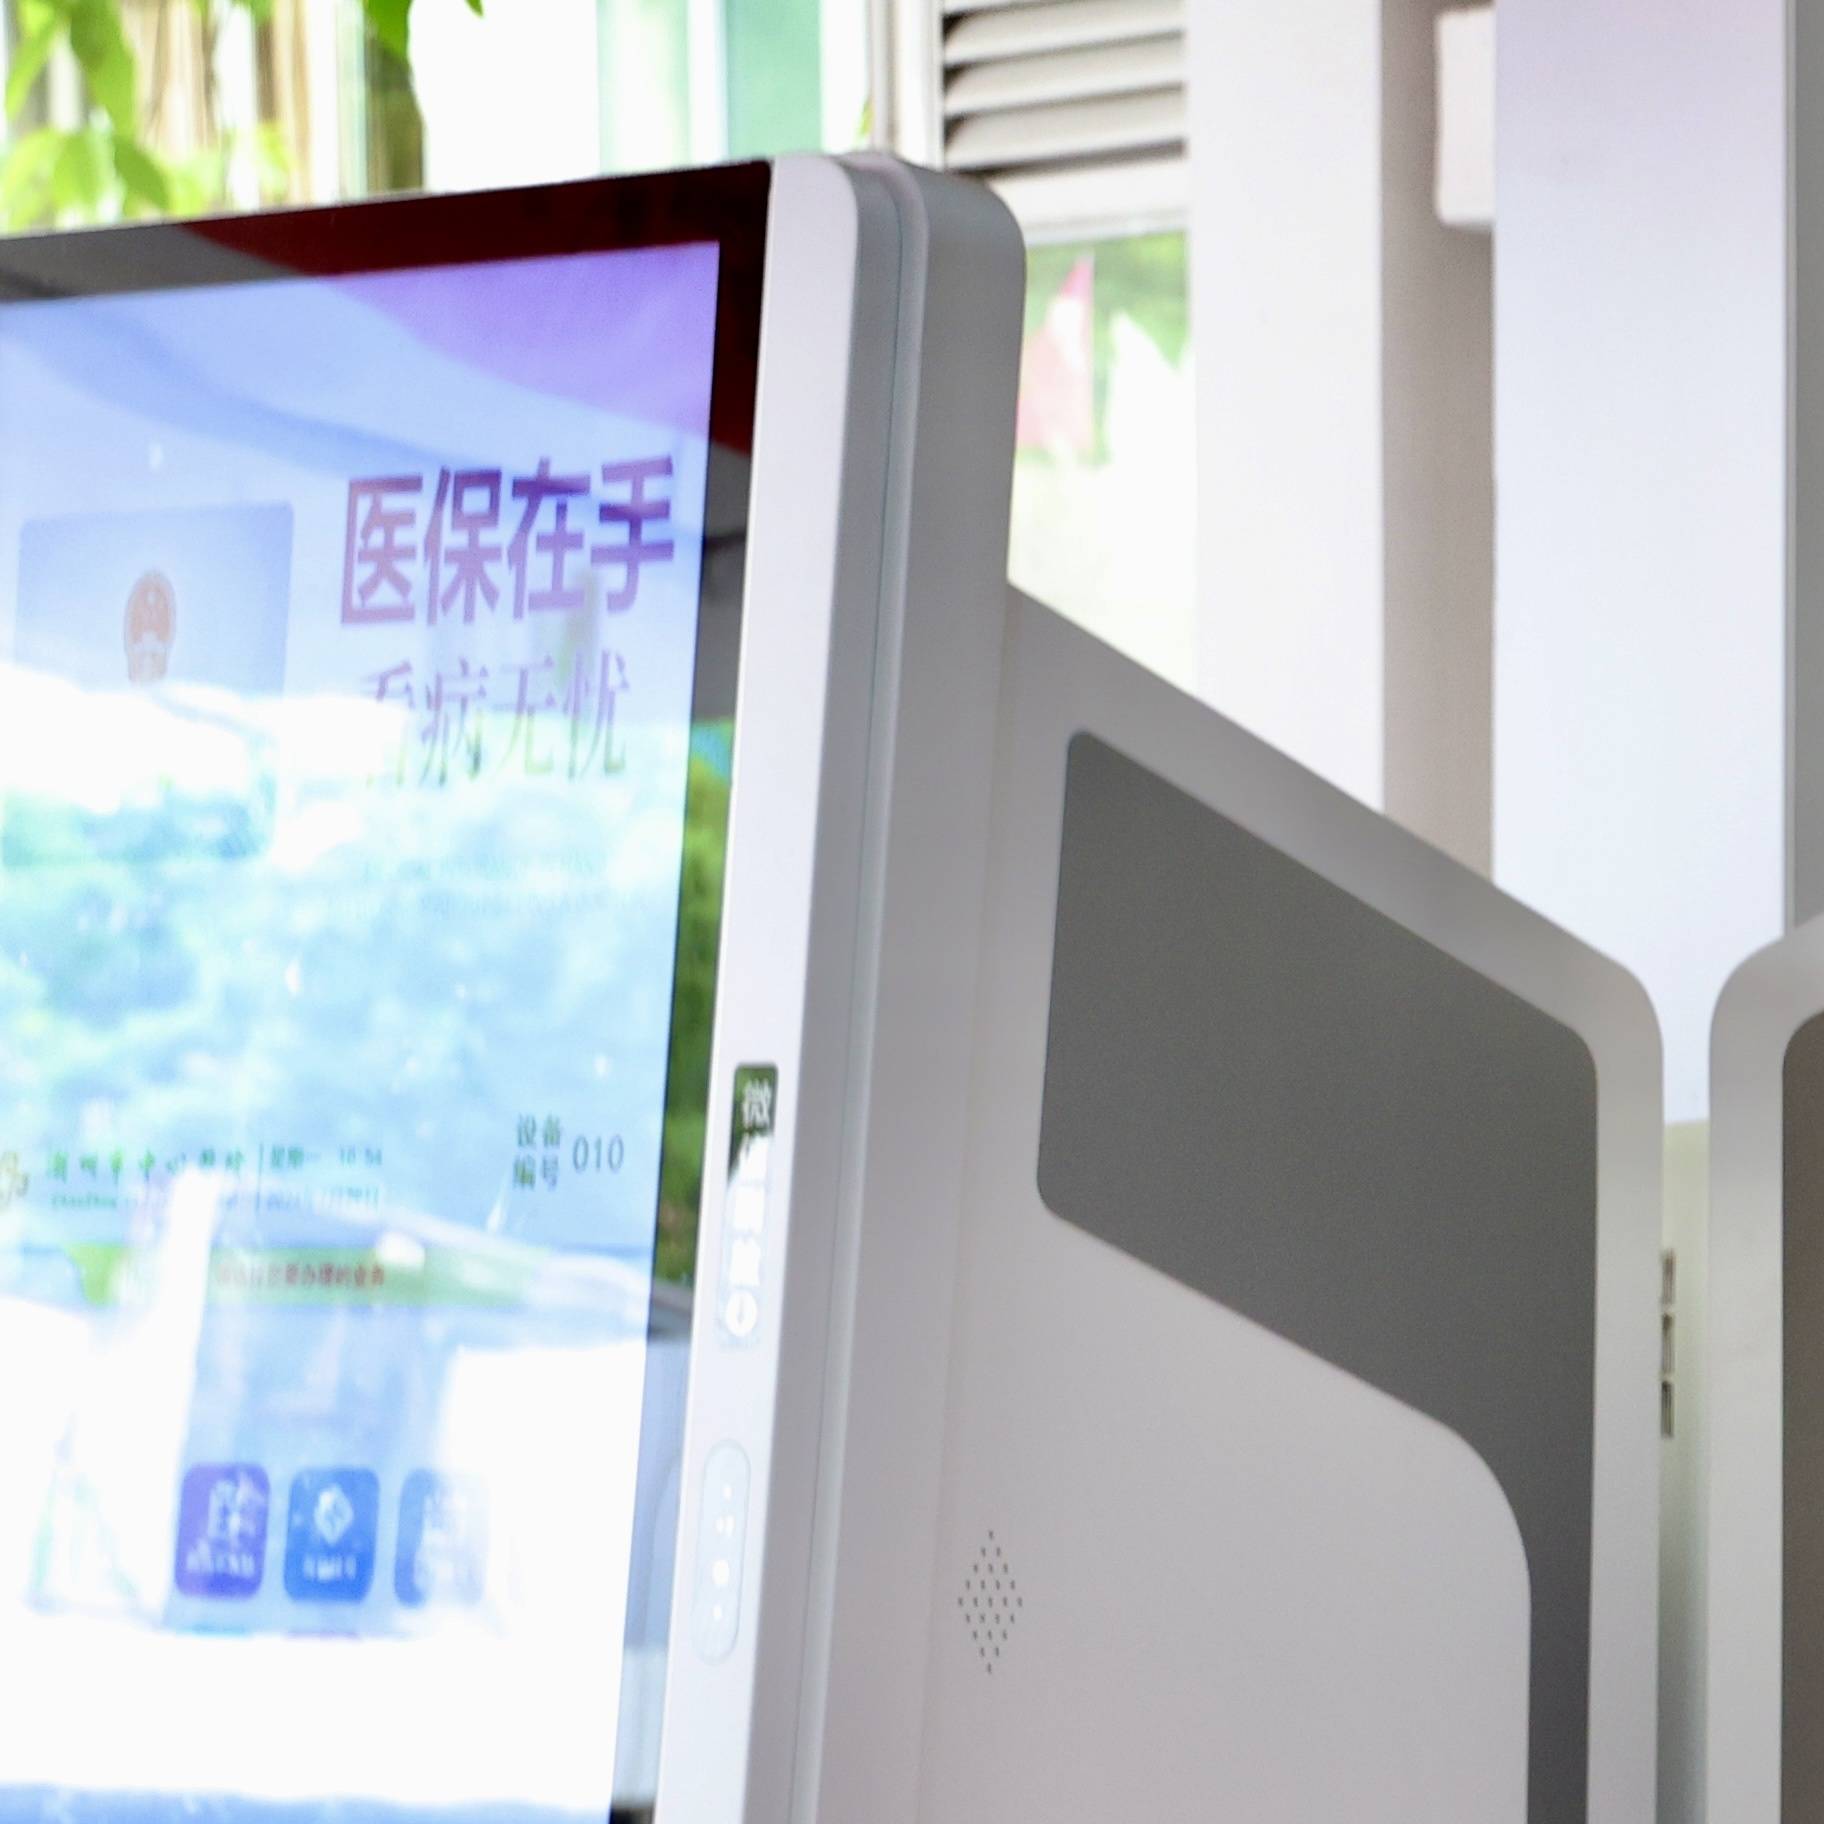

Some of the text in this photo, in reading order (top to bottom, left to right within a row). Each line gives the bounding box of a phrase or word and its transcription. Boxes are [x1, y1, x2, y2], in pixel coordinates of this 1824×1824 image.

[341, 454, 674, 627] 医保在手
[573, 1134, 624, 1174] 010
